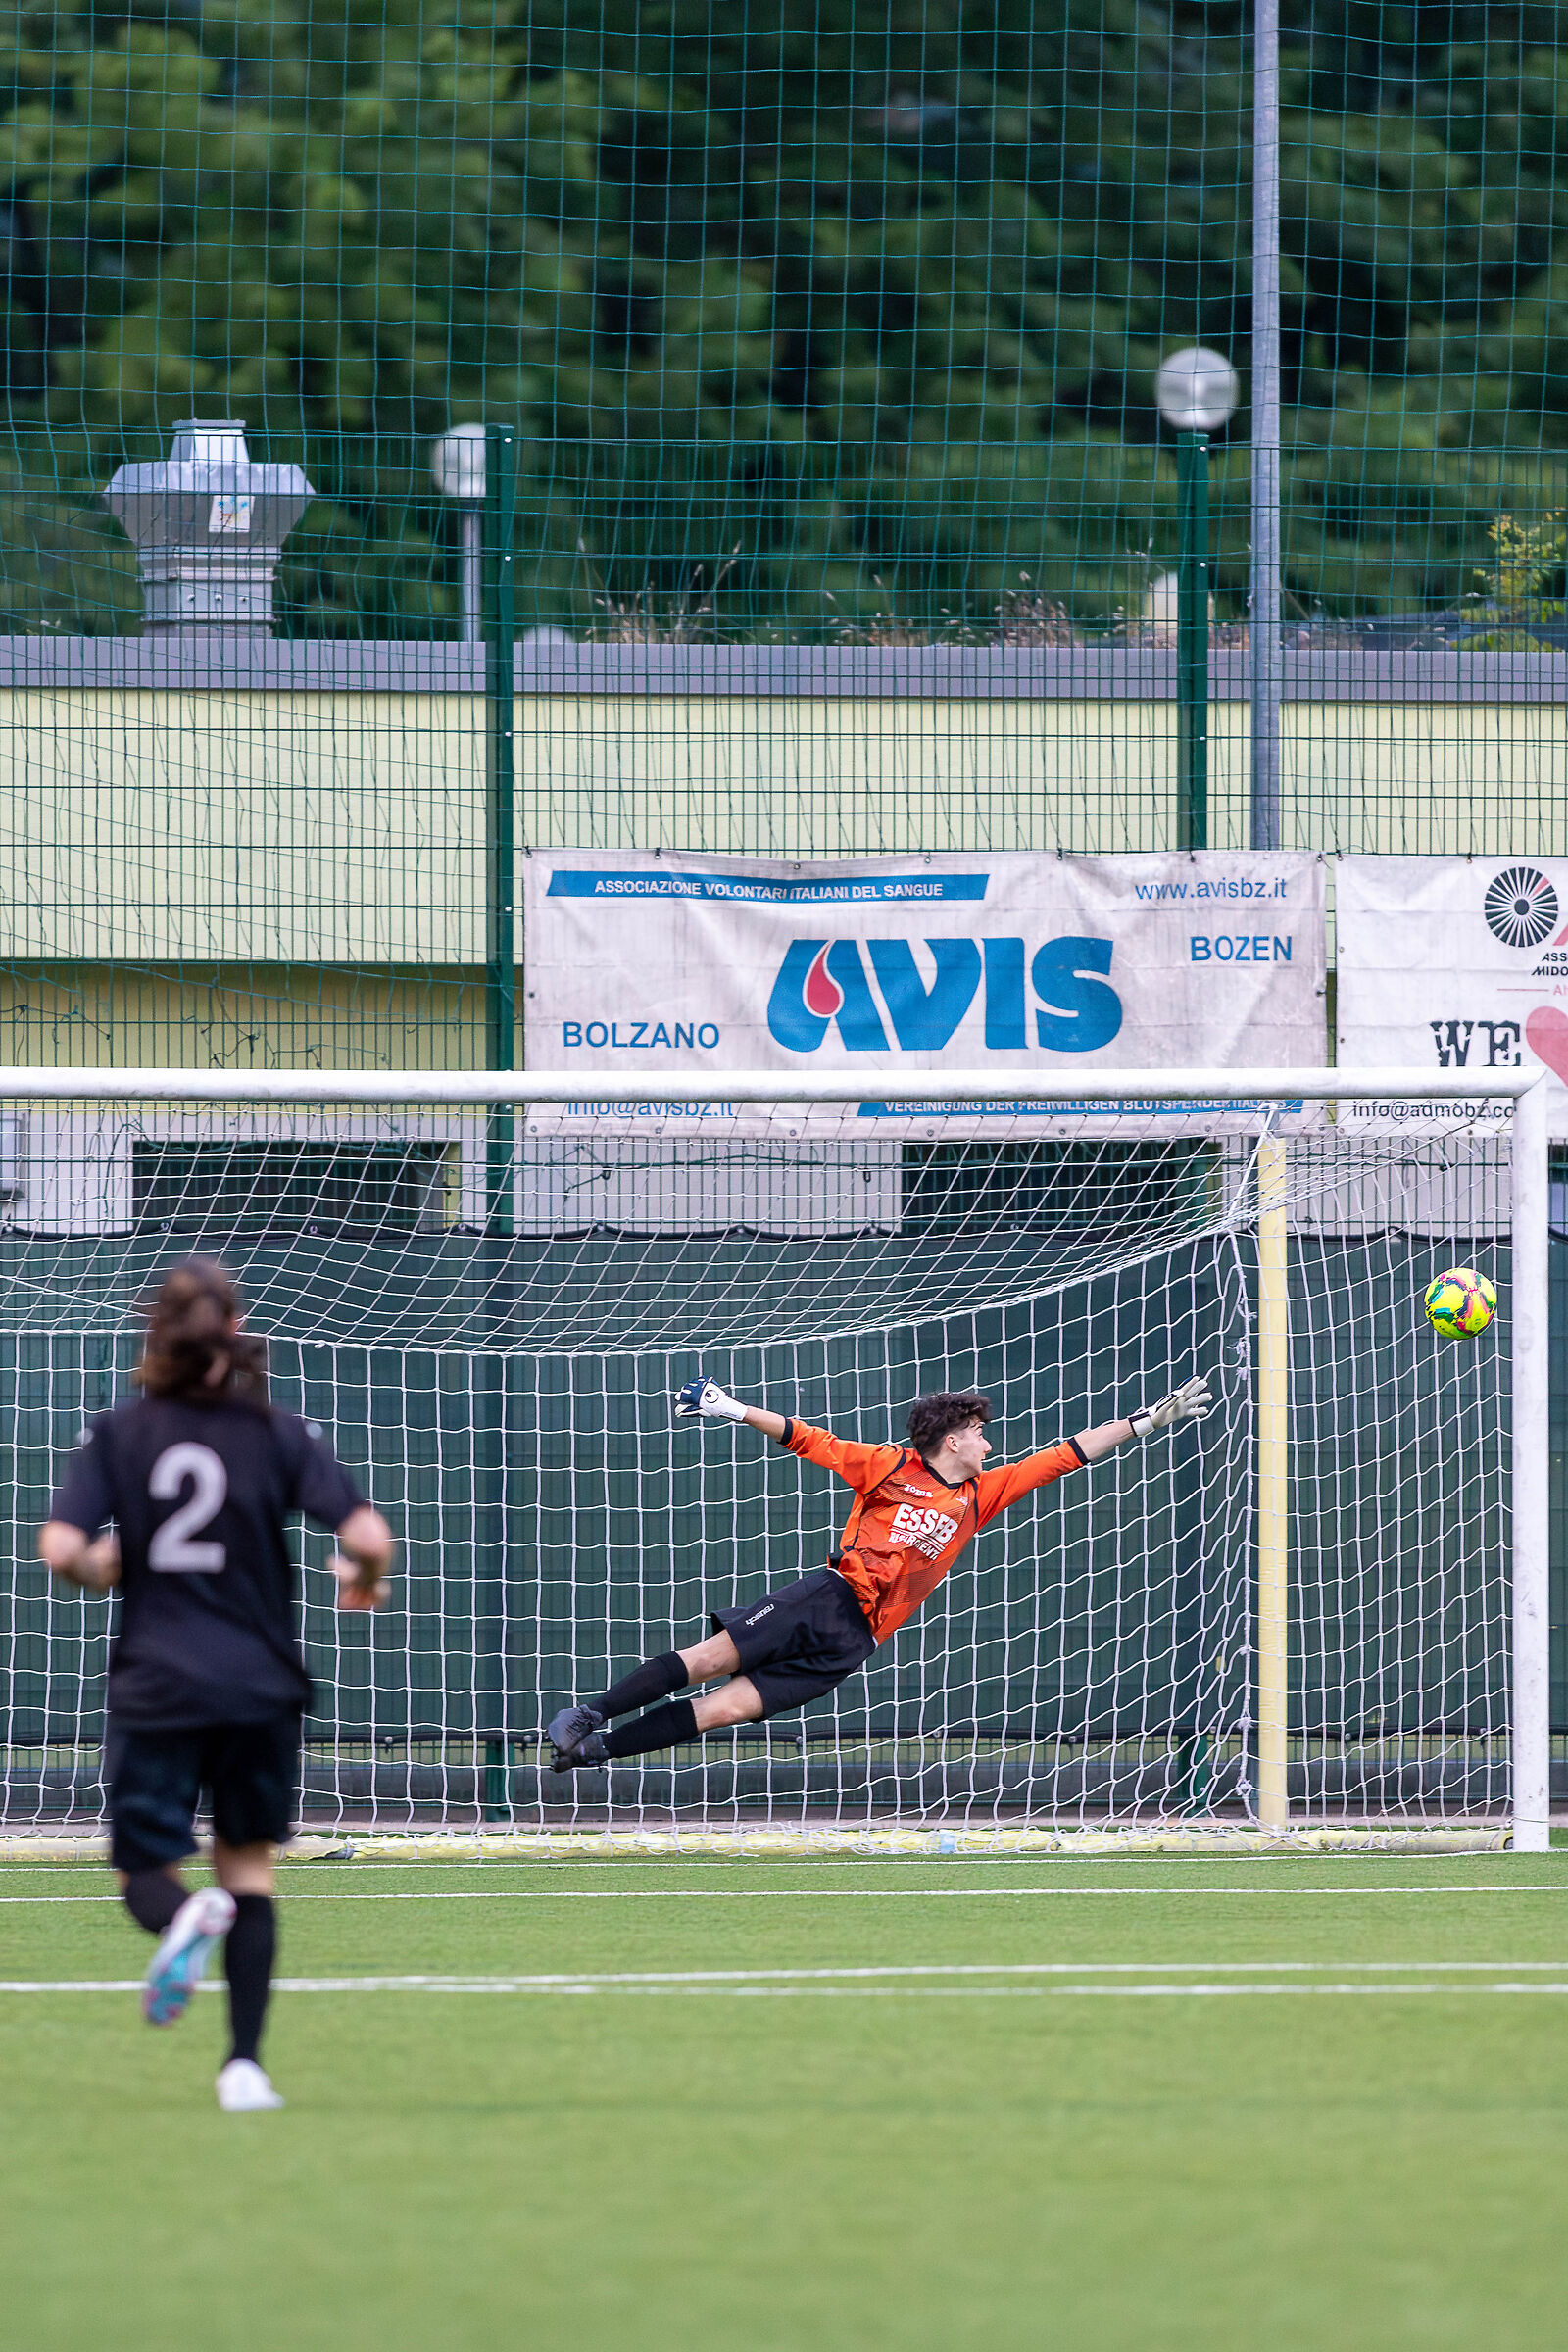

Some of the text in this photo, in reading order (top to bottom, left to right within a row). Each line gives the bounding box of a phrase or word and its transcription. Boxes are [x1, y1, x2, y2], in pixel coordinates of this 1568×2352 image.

[594, 880, 943, 900] ASSOCIAZIONE VOLONTARI ITALIANI DEL SANGUE
[1135, 877, 1287, 900] www.avisbz.it
[1191, 936, 1293, 961] BOZEN
[767, 936, 1123, 1053] AVIS
[564, 1021, 720, 1048] BOLZANO
[1430, 1020, 1521, 1067] WE
[885, 1101, 981, 1112] VEREINIGUNG
[985, 1101, 1015, 1111] DER
[148, 1442, 227, 1573] 2
